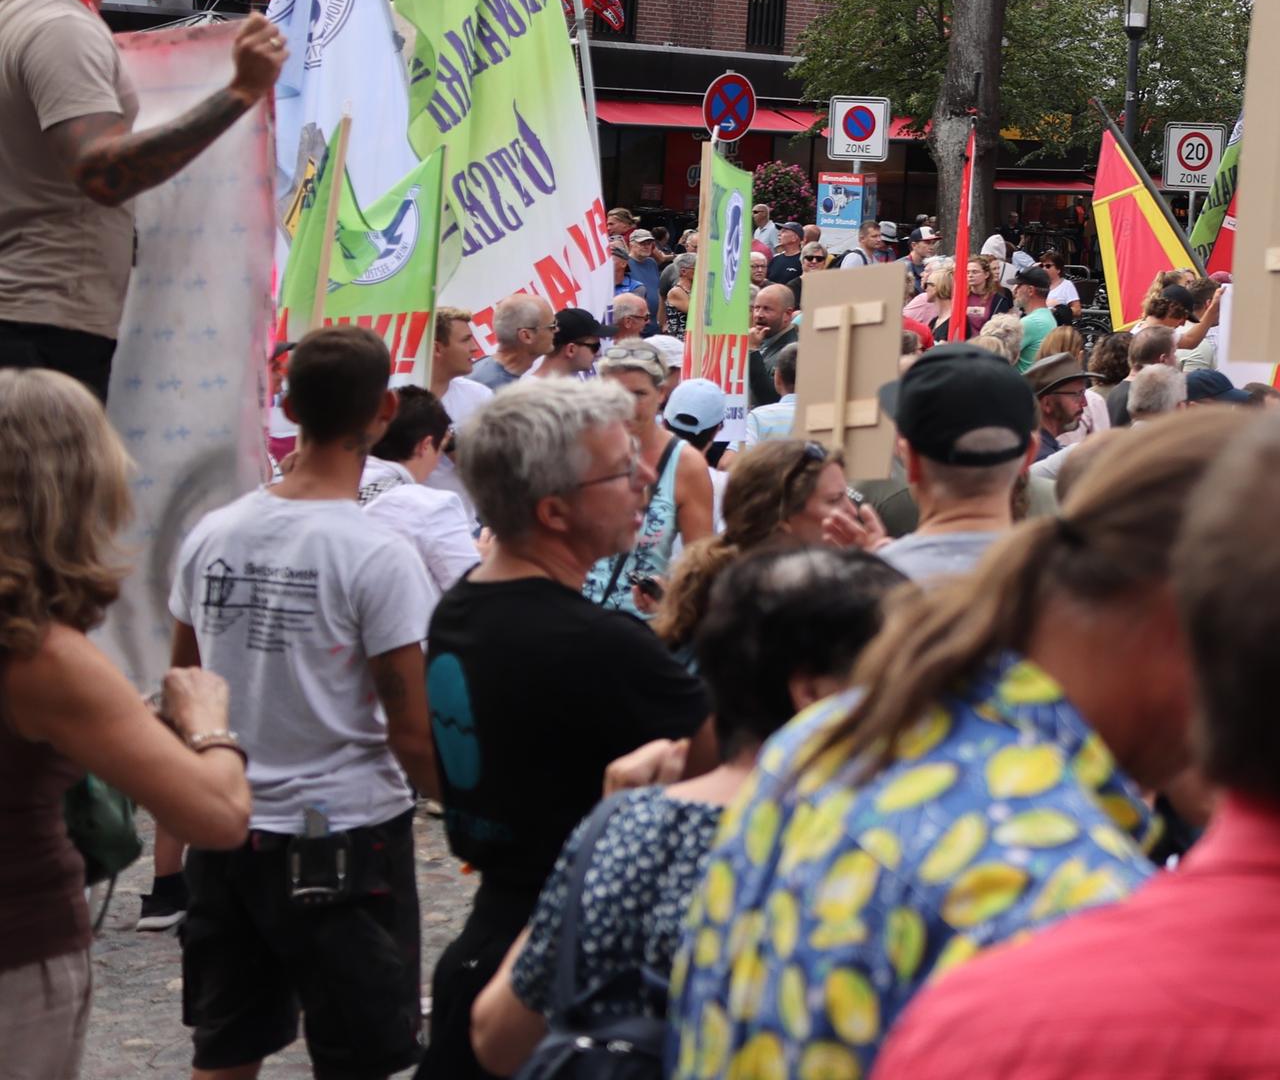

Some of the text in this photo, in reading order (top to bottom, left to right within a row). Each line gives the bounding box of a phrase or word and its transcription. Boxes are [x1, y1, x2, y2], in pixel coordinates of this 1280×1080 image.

[845, 143, 871, 153] ZONE
[1185, 143, 1206, 161] 20
[1180, 173, 1207, 184] ZONE
